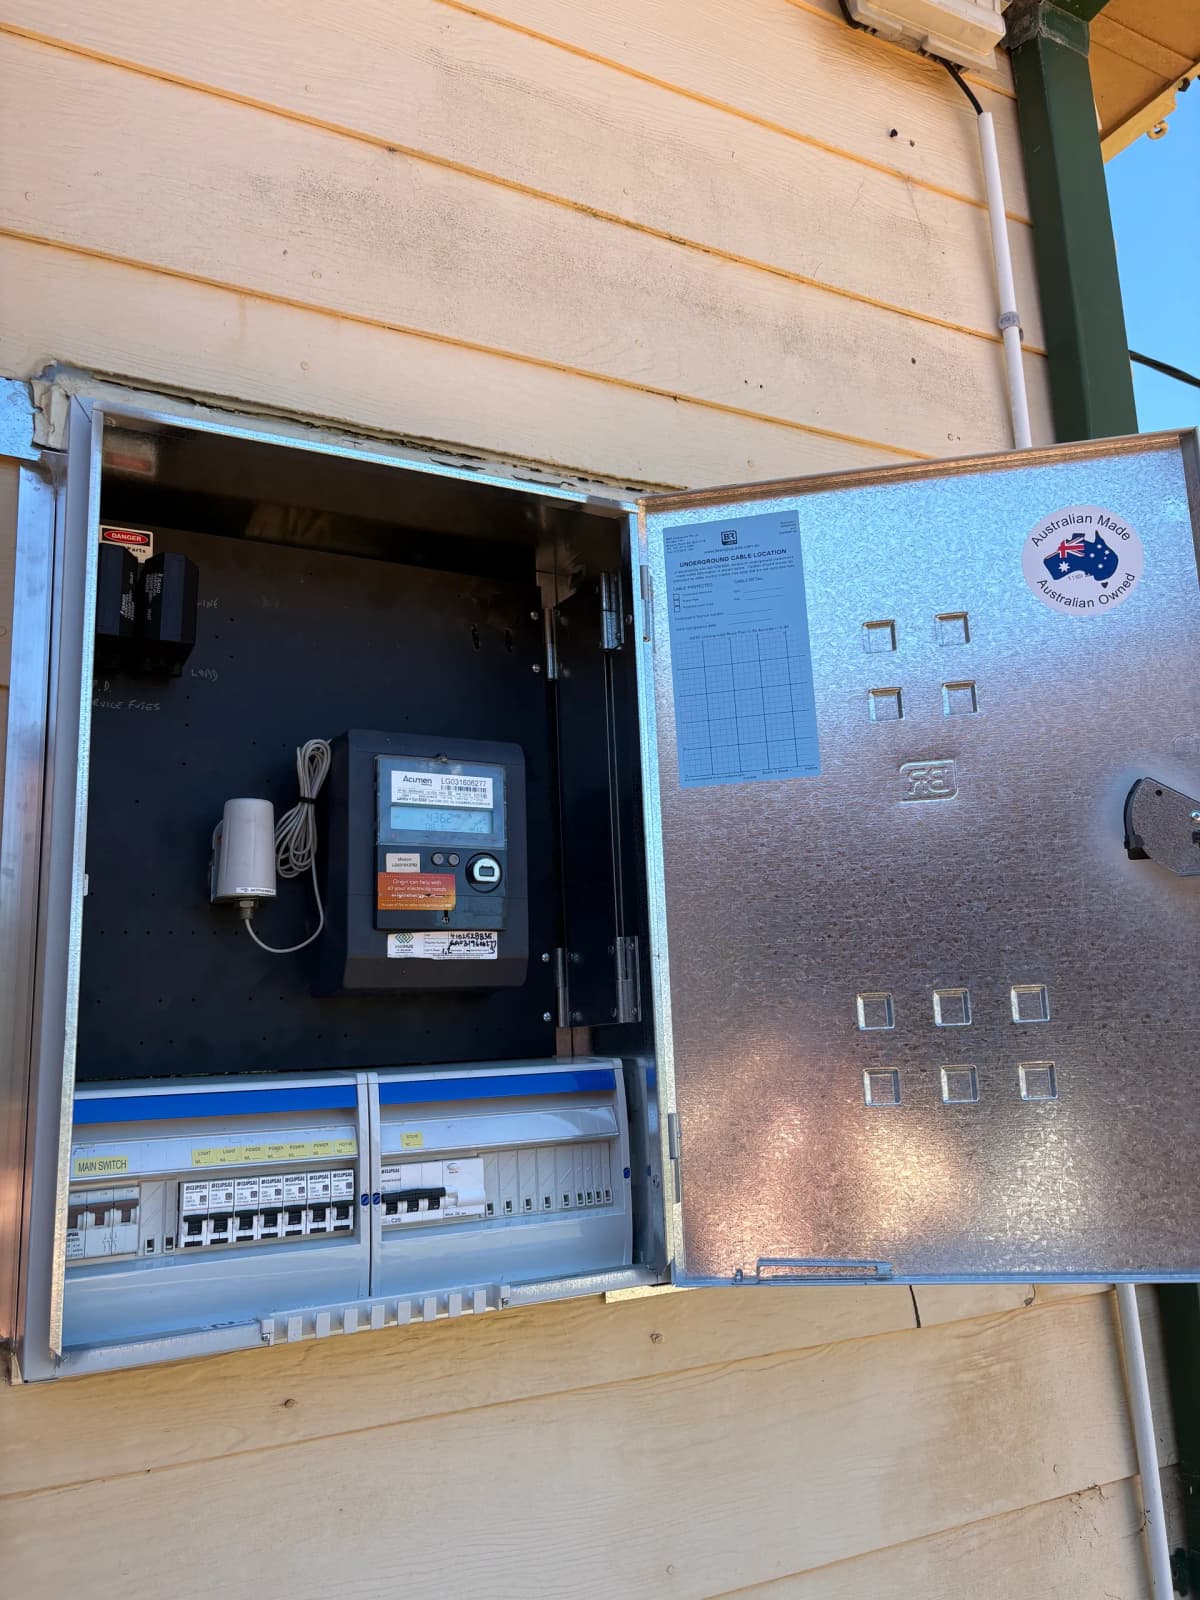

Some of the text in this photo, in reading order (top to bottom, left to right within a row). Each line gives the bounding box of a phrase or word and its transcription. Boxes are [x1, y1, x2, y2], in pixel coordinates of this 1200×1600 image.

[111, 532, 142, 542] DANGER
[1032, 514, 1130, 547] Australian Made
[679, 556, 729, 567] UNDERGROUND
[730, 552, 752, 561] CABLE
[753, 549, 787, 558] LOCATION
[1037, 572, 1136, 608] Australian Owned
[128, 700, 160, 711] FUSES
[403, 775, 432, 785] Acumen
[78, 1159, 127, 1172] MAIN SWITCH
